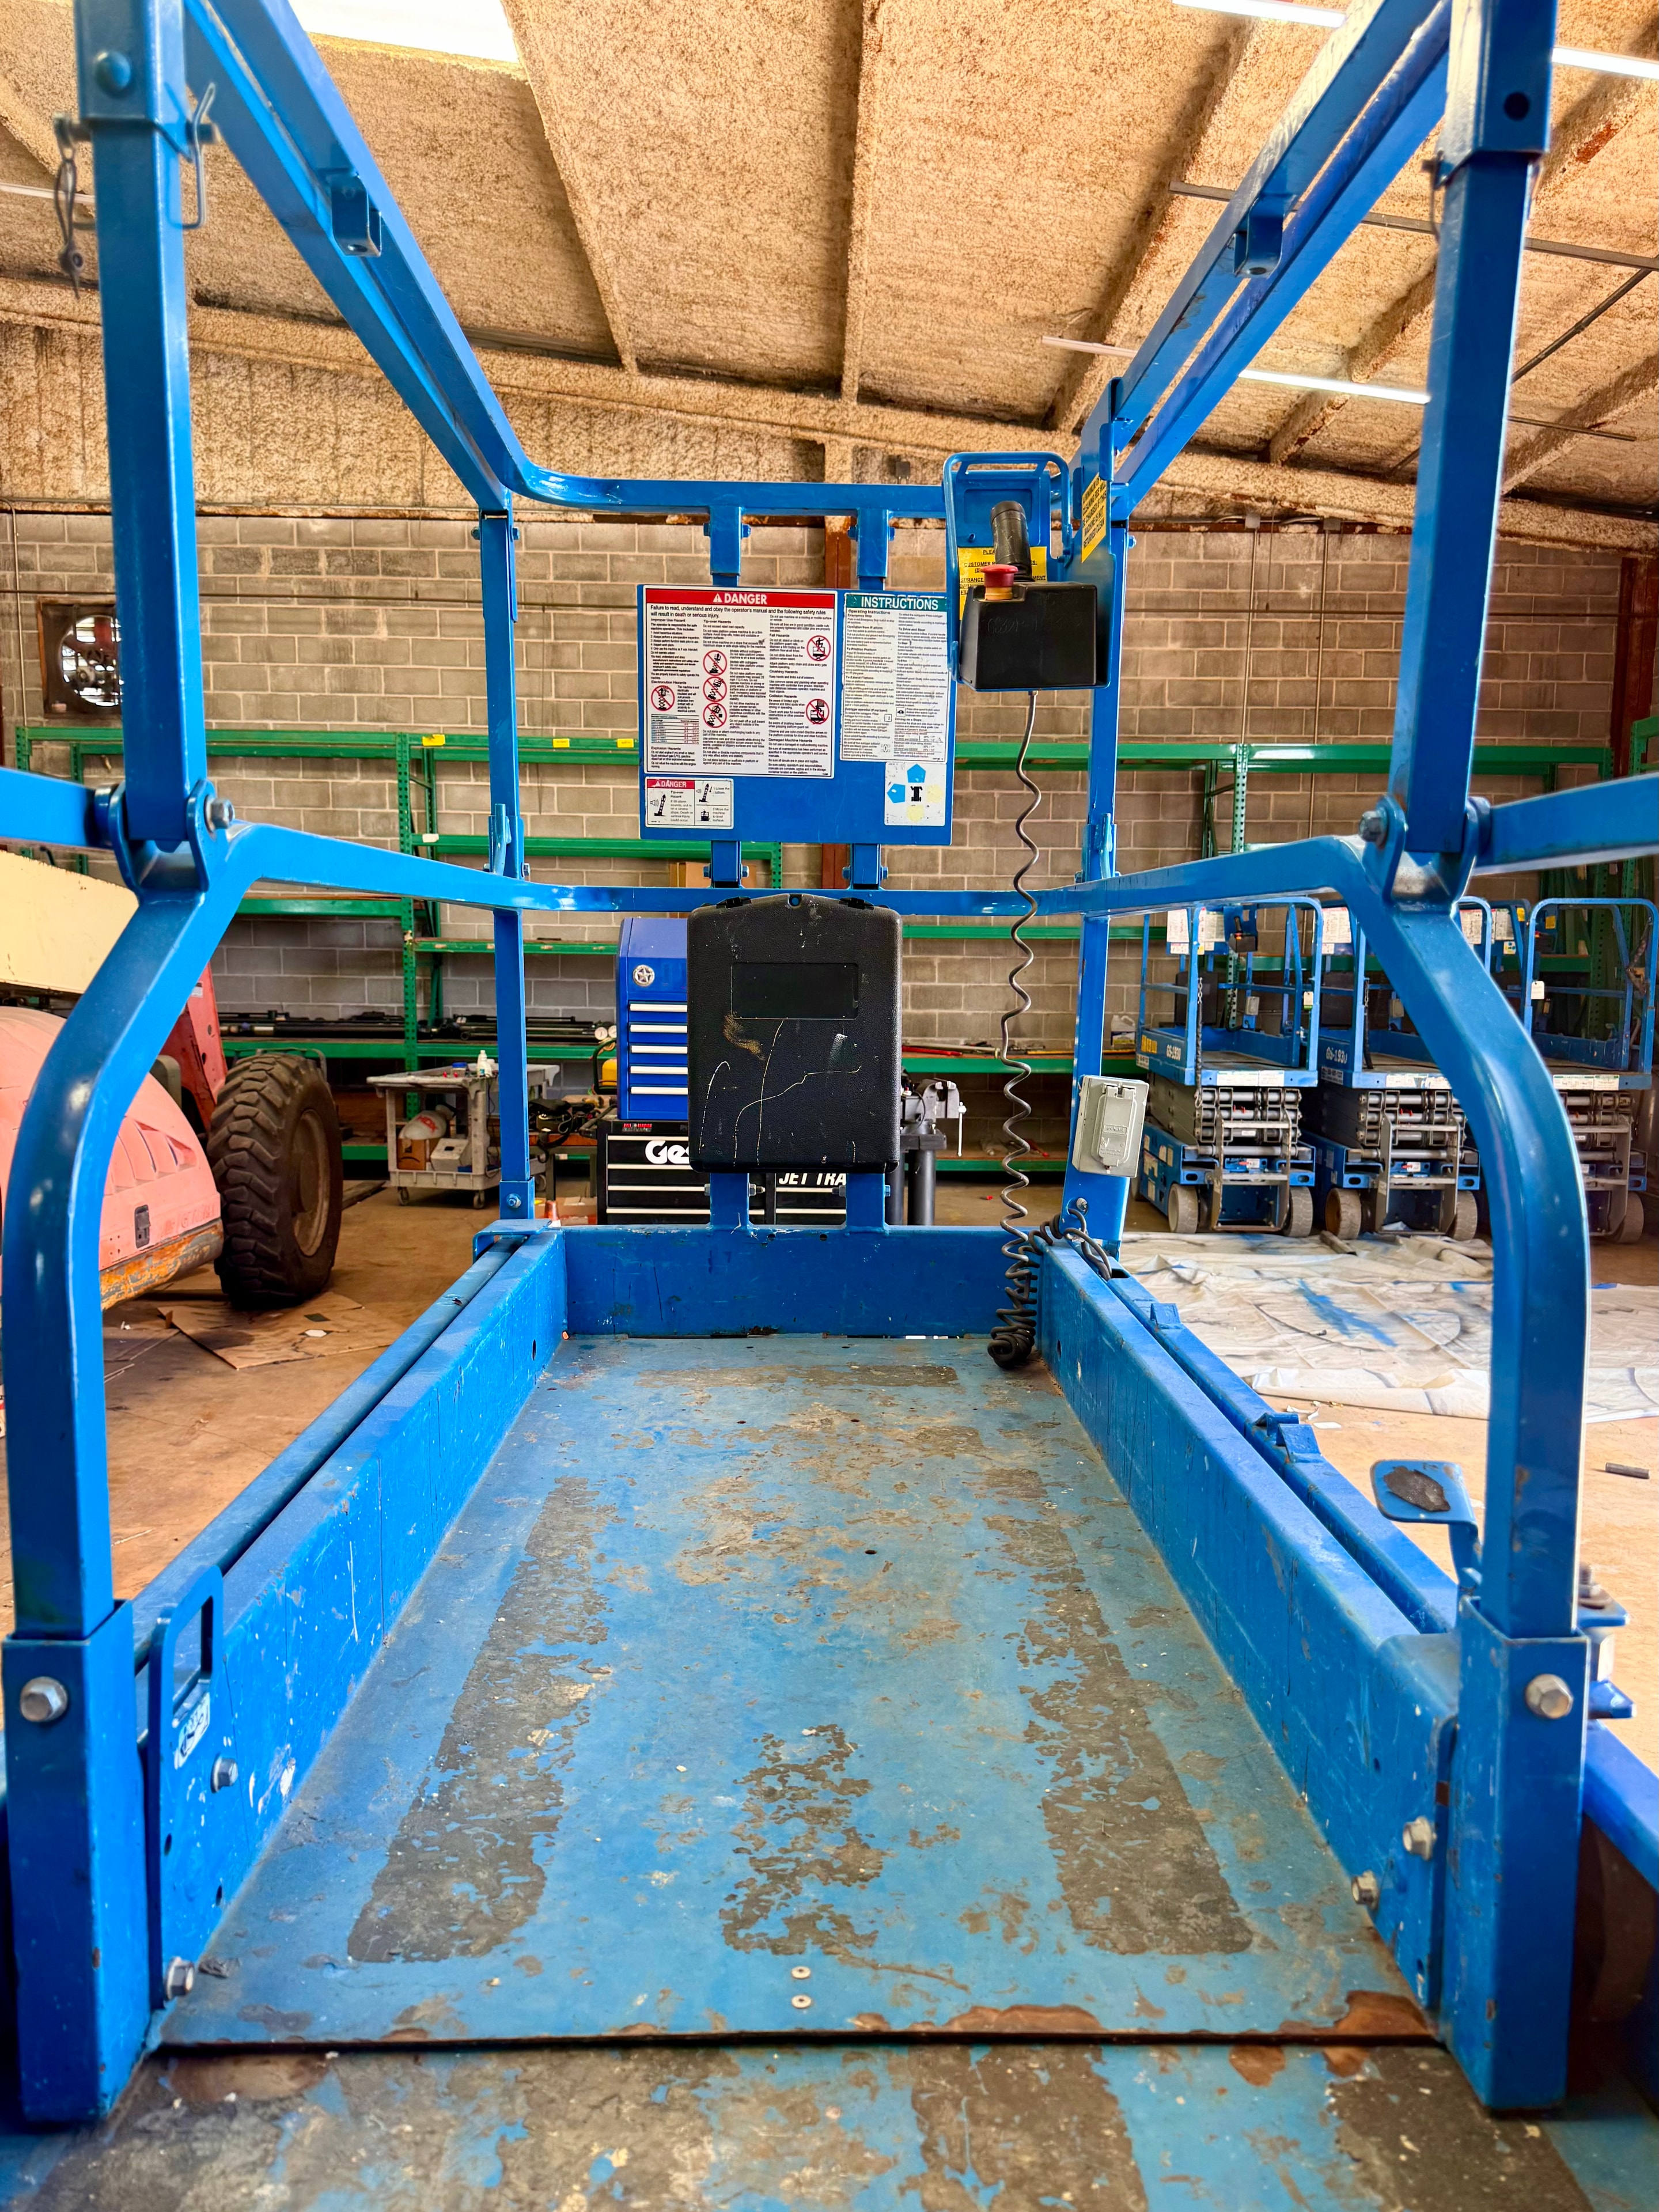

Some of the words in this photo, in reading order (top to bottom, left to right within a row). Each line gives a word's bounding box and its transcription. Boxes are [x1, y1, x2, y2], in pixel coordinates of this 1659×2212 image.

[1083, 495, 1093, 516] CLEANING
[1086, 503, 1096, 523] CHARGED
[1084, 517, 1094, 536] MACHINE
[1084, 528, 1095, 549] RETURNED
[725, 593, 767, 604] DANGER
[861, 596, 938, 610] INSTRUCTIONS
[1166, 1044, 1181, 1061] GS-1930
[645, 1140, 690, 1164] Ge
